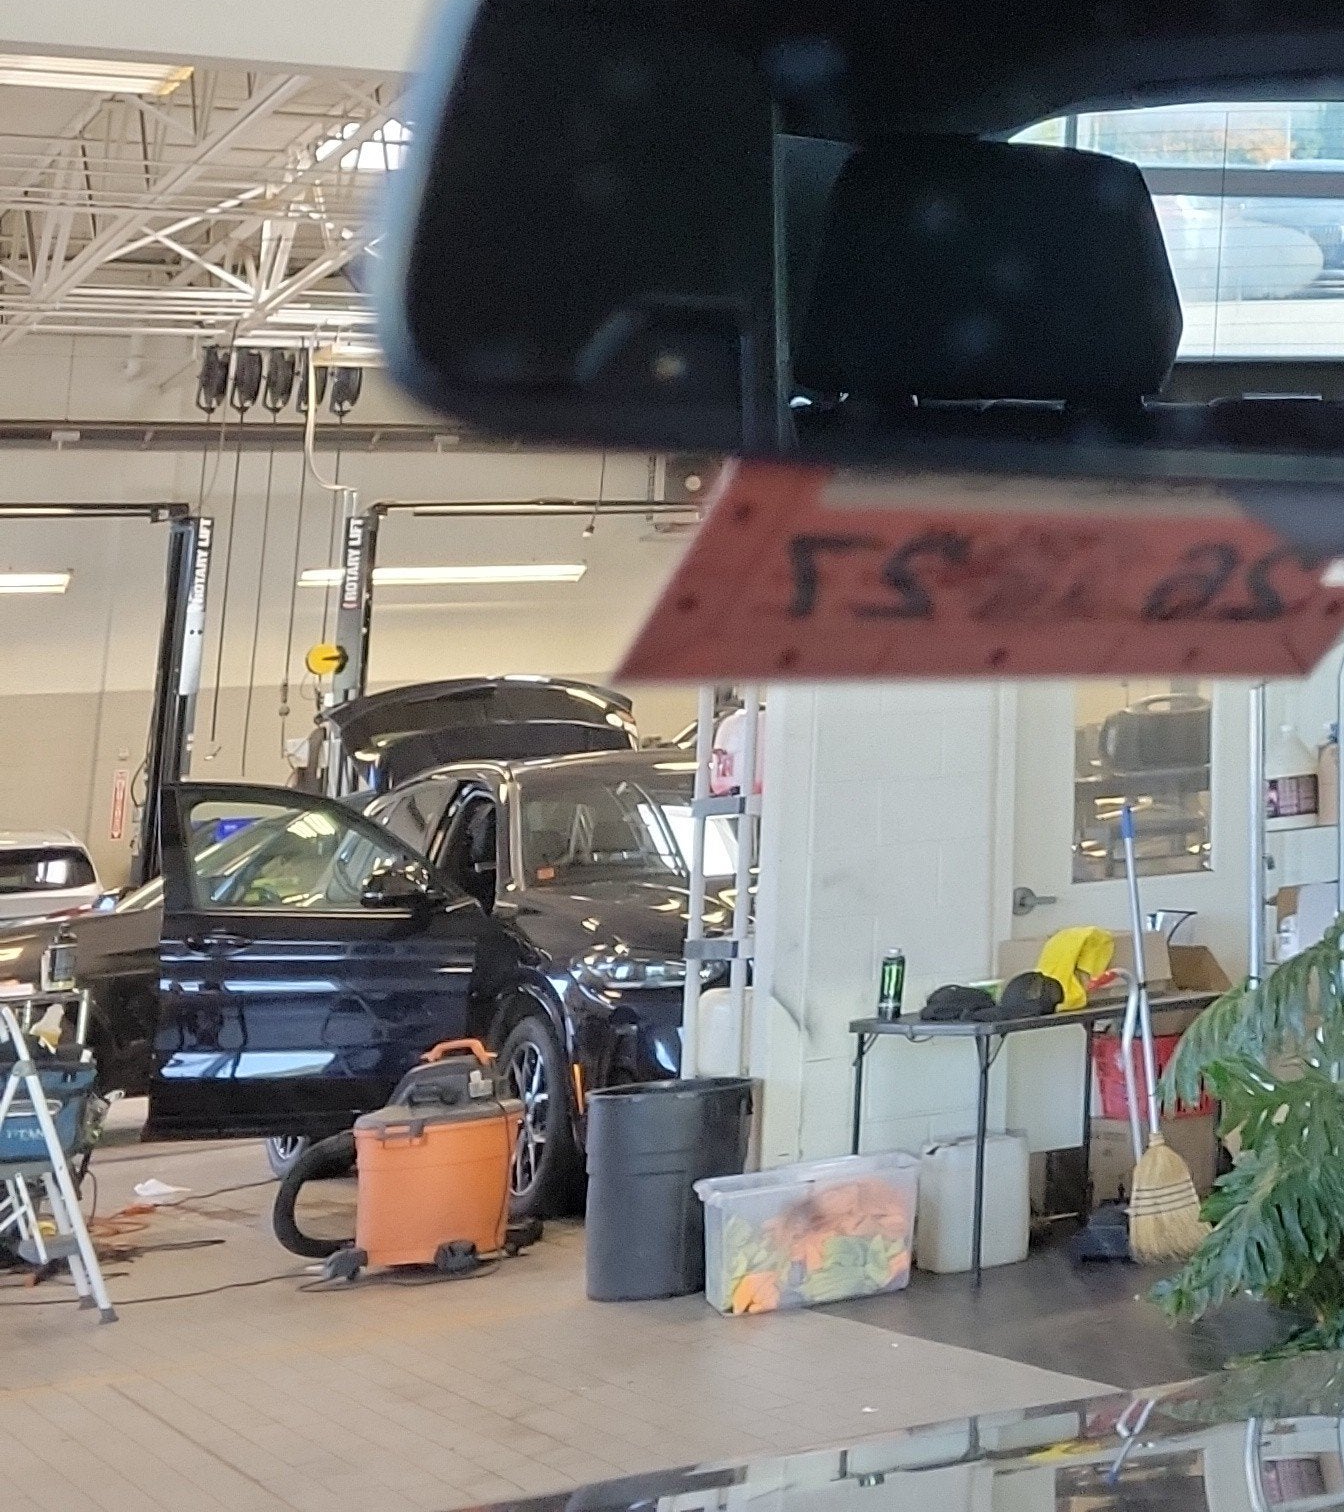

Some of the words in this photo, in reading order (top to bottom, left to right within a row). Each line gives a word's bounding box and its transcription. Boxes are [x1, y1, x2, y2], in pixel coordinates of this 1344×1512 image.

[198, 517, 213, 548] LIFT
[348, 517, 364, 547] LIFT
[344, 548, 361, 602] ROTARY
